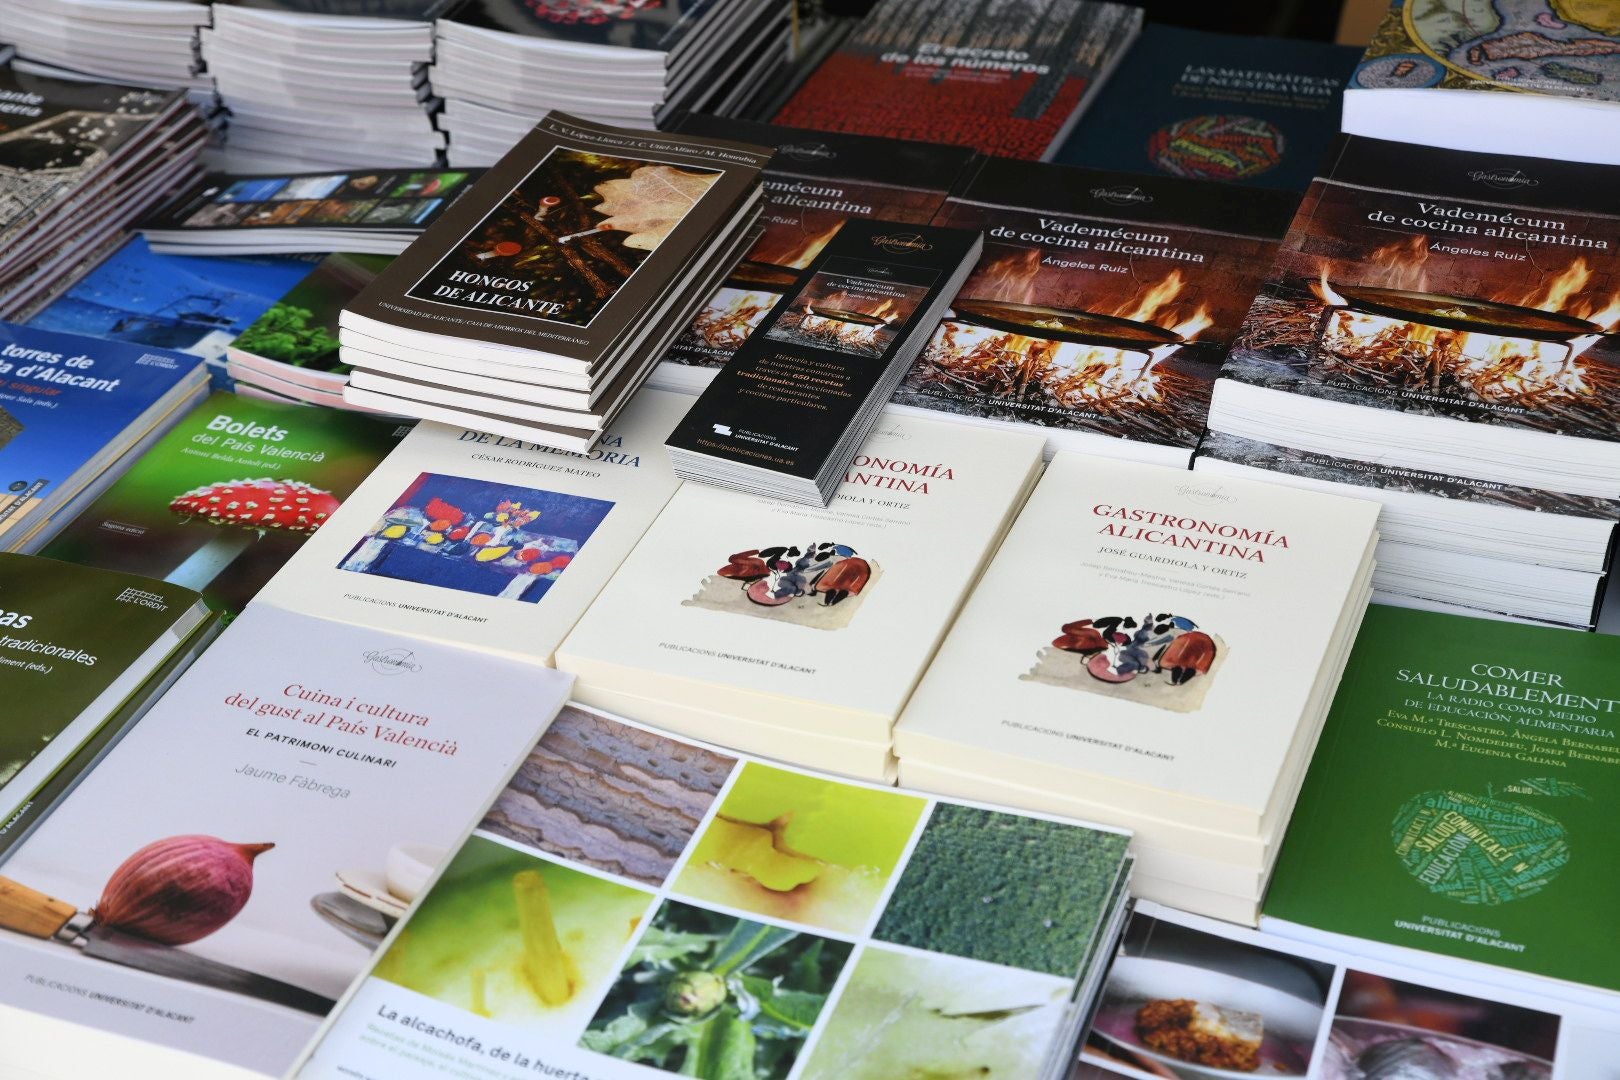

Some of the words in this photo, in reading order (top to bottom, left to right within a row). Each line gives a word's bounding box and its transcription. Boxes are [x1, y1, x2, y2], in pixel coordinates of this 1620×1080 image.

[880, 52, 909, 63] de
[913, 54, 946, 66] los
[951, 56, 1050, 76] números
[918, 43, 941, 54] El
[944, 45, 1030, 61] secreto
[771, 194, 872, 215] alicantina
[1418, 202, 1566, 230] Vademécum
[772, 216, 799, 226] Ruiz
[1038, 218, 1170, 244] Vademécum
[1368, 210, 1396, 224] de
[1401, 216, 1479, 235] cocina
[1484, 226, 1608, 250] alicantina
[990, 226, 1016, 239] de
[1020, 231, 1089, 250] cocina
[1094, 240, 1204, 263] alicantina
[1430, 242, 1490, 258] Ángeles
[1494, 251, 1526, 262] Ruiz
[1042, 256, 1095, 270] Ángeles
[1099, 264, 1128, 274] Ruiz
[449, 270, 534, 292] HONGOS
[846, 278, 894, 290] Vademécum
[864, 286, 905, 298] alicantina
[434, 285, 464, 298] DE
[462, 289, 564, 315] ALICANTE
[378, 302, 422, 317] UNIVERSIDAD
[431, 315, 462, 324] ALICANTE
[492, 324, 523, 333] AHORROS
[1, 344, 64, 364] torres
[64, 355, 95, 369] de
[771, 360, 805, 371] nuestras
[806, 367, 844, 380] comarcas
[775, 354, 808, 365] Historia
[816, 361, 845, 372] cultura
[16, 364, 120, 392] d'Alacant
[736, 370, 794, 386] tradicionales
[810, 376, 844, 388] recetas
[744, 389, 776, 400] cocinas
[768, 385, 820, 400] restaurantes
[922, 388, 986, 404] PUBLICACIONS
[988, 400, 1046, 412] UNIVERSITAT
[1048, 407, 1098, 420] D'ALACANT
[1326, 380, 1398, 396] PUBLICACIONS
[1401, 392, 1466, 406] UNIVERSITAT
[1468, 401, 1524, 414] D'ALACANT
[206, 414, 288, 442] Bolets
[457, 430, 492, 444] DE
[495, 436, 523, 449] LA
[735, 434, 770, 445] UNIVERSITAT
[192, 433, 220, 445] del
[221, 438, 256, 453] País
[260, 444, 326, 463] Valencià
[471, 453, 504, 464] CÉSAR
[504, 458, 564, 473] RODRÍGUEZ
[564, 468, 600, 478] MATEO
[853, 455, 954, 480] ONOMÍA
[1305, 456, 1376, 473] PUBLICACIONS
[1380, 468, 1444, 482] UNIVERSITAT
[1447, 476, 1503, 490] D'ALACANT
[1093, 504, 1290, 549] GASTRONOMÍA
[1097, 523, 1265, 563] ALICANTINA
[1098, 546, 1128, 557] JOSÉ
[1128, 551, 1198, 572] GUARDIOLA
[1202, 564, 1209, 572] Y
[1210, 567, 1248, 580] ORTIZ
[134, 597, 168, 612] L'ORDIT
[343, 593, 396, 607] PUBLICACIONS
[398, 604, 446, 616] UNIVERSITAT
[447, 612, 489, 624] D'ALACANT
[0, 635, 98, 666] tradicionales
[658, 642, 717, 657] PUBLICACIONS
[718, 652, 770, 666] UNIVERSITAT
[770, 661, 816, 674] D'ALACANT
[1470, 663, 1564, 688] COMER
[1396, 669, 1620, 714] SALUDABLEMENT
[284, 684, 342, 708] Cuina
[346, 697, 357, 710] i
[356, 702, 430, 728] cultura
[1404, 699, 1423, 709] DE
[1428, 703, 1512, 723] EDUCACIÓN
[1518, 717, 1616, 738] ALIMENTARIA
[1426, 691, 1444, 701] LA
[1450, 695, 1494, 708] RADIO
[1498, 702, 1543, 716] COMO
[1548, 710, 1597, 724] MEDIO
[224, 693, 259, 710] del
[258, 703, 302, 721] gust
[303, 711, 325, 726] al
[325, 714, 368, 736] País
[372, 725, 458, 757] Valencià
[246, 728, 260, 738] EL
[264, 732, 334, 755] PATRIMONI
[336, 748, 397, 769] CULINARI
[1066, 733, 1124, 750] UNIVERSITAT
[1124, 746, 1176, 762] D'ALACANT
[235, 763, 286, 785] Jaume
[289, 774, 350, 800] Fàbrega
[1507, 784, 1533, 794] SALUD
[1415, 822, 1456, 852] SALUD
[1394, 920, 1463, 940] UNIVERSITAT
[1465, 934, 1526, 952] D'ALACANT
[1422, 915, 1500, 938] PUBLICACIONS
[89, 991, 146, 1011] UNIVERSITAT
[376, 1004, 398, 1022] La
[400, 1013, 484, 1054] alcachofa,
[490, 1046, 511, 1062] de
[514, 1052, 530, 1068] la
